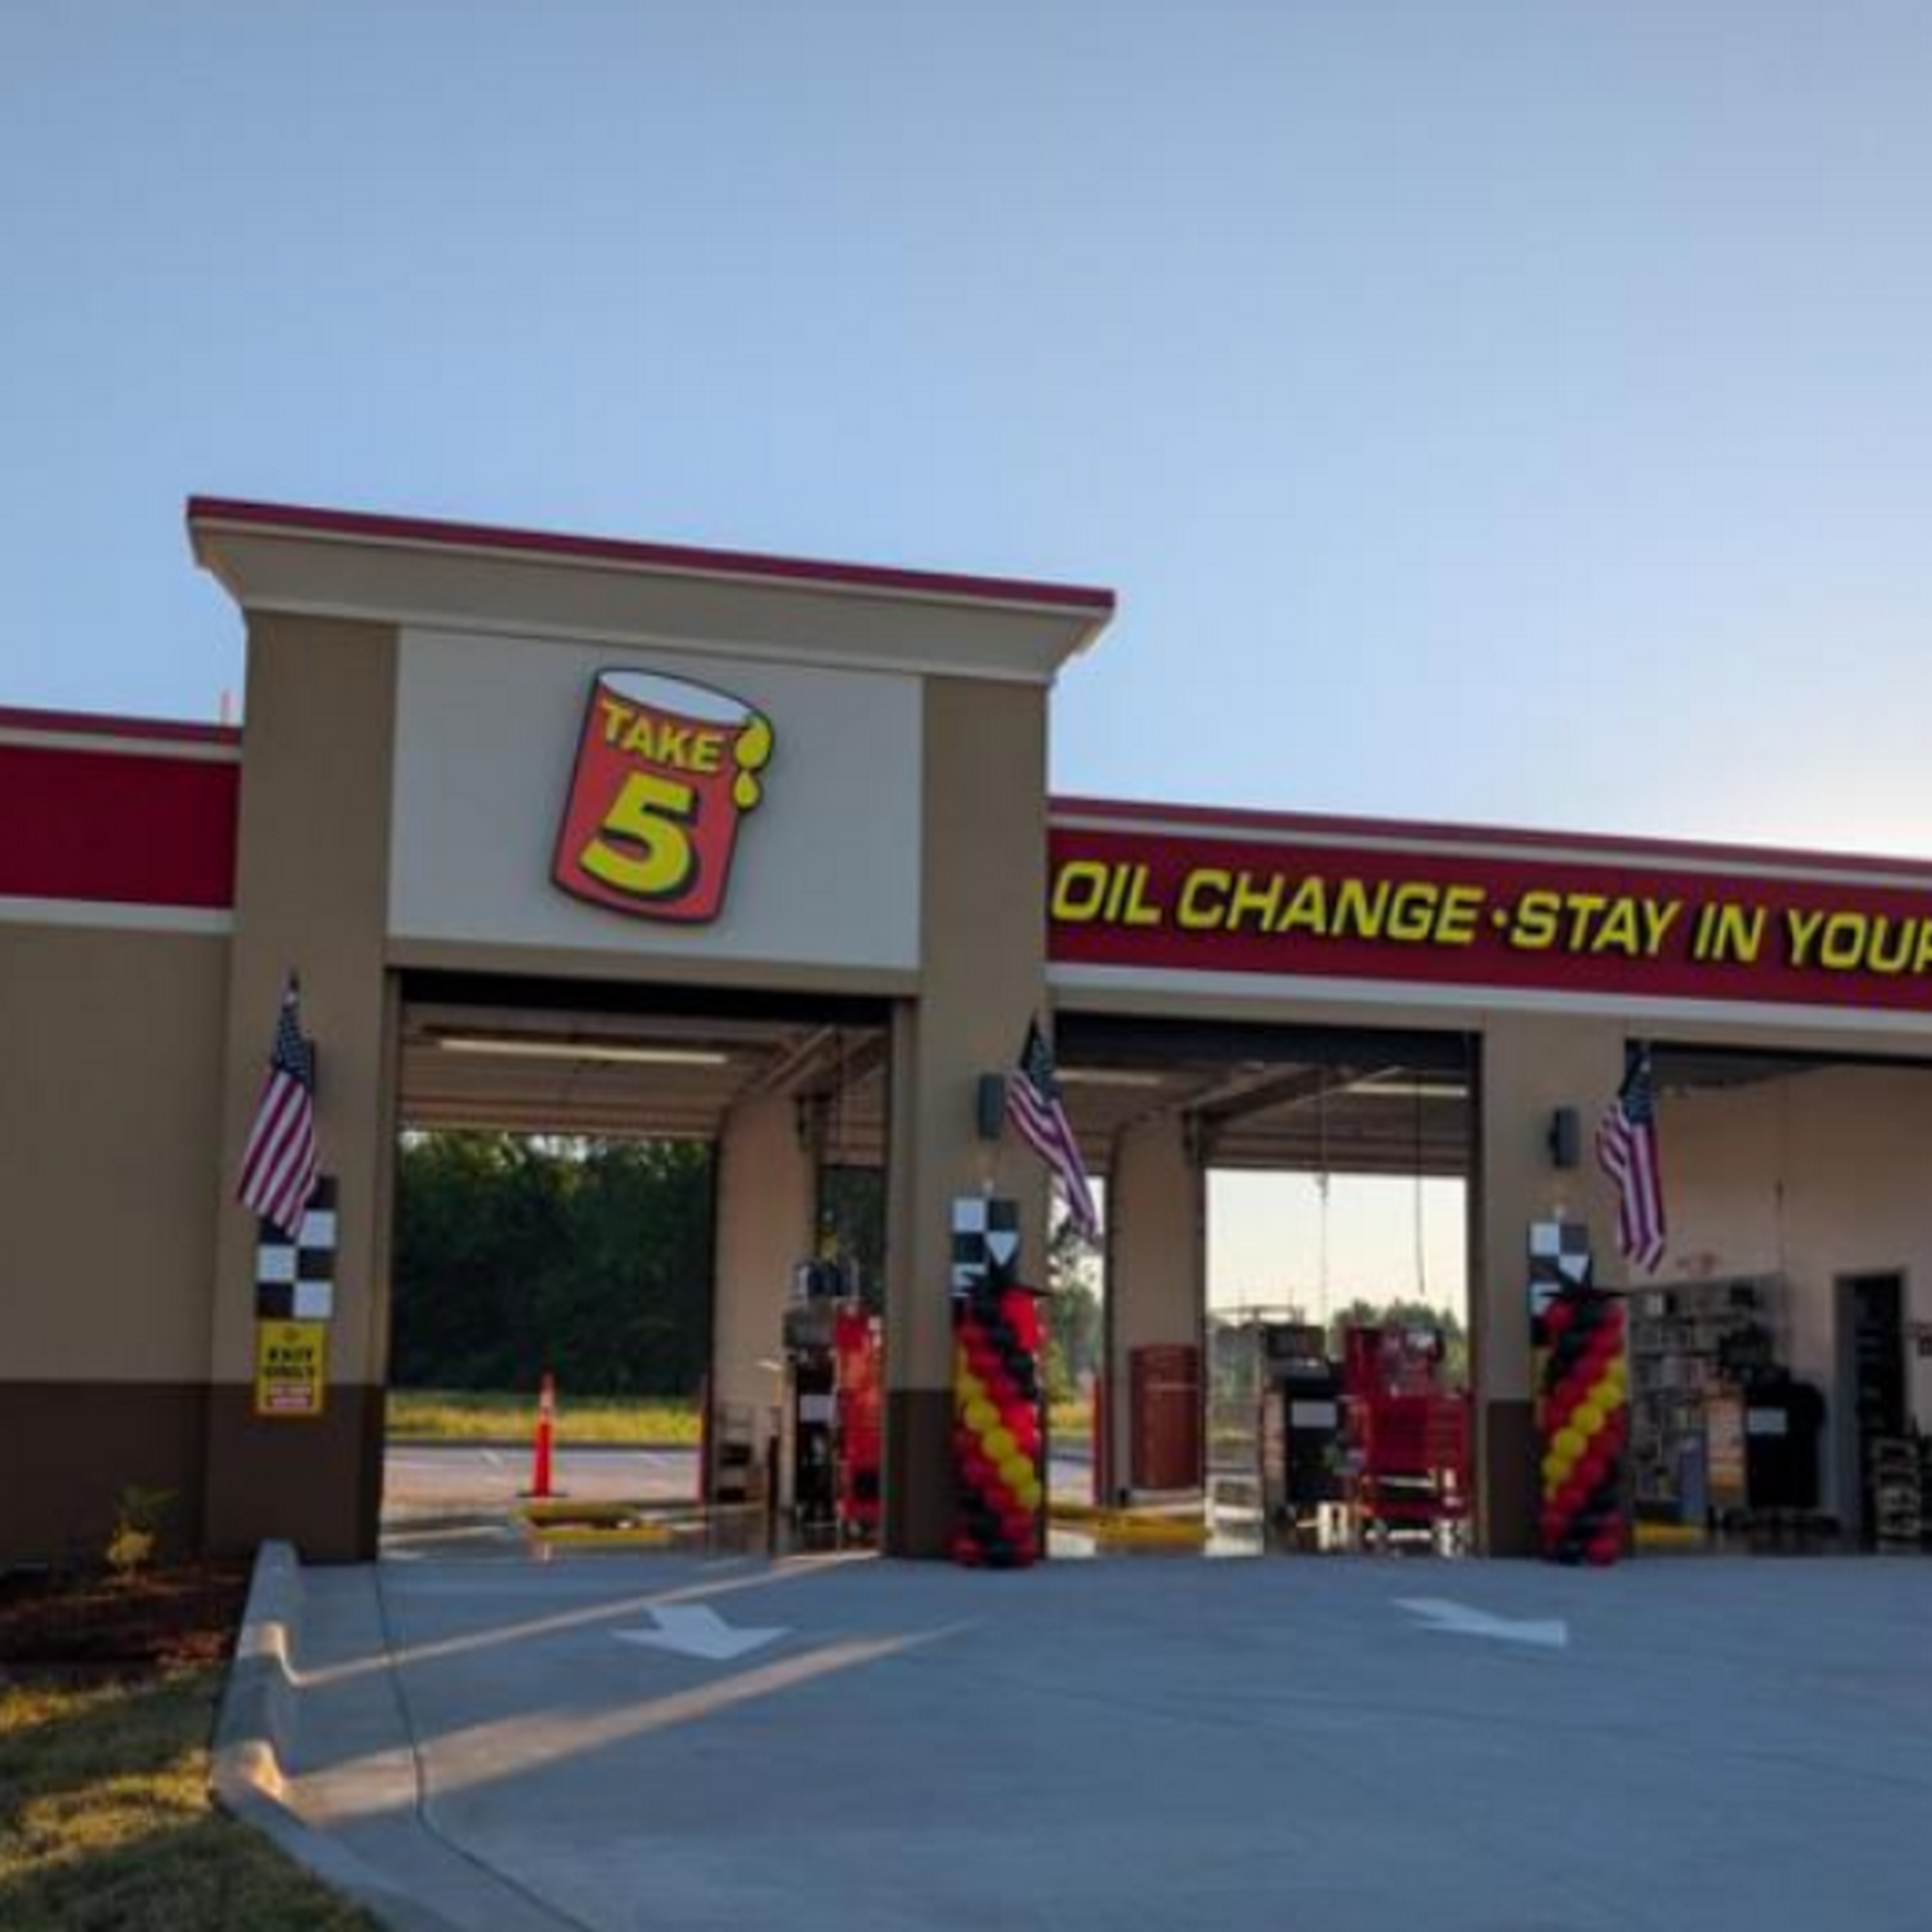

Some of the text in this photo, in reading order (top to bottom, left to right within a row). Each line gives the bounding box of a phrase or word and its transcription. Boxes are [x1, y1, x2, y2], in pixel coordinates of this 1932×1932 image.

[601, 698, 724, 773] TAKE
[581, 771, 694, 894] 5
[1051, 861, 1161, 924] OIL
[1177, 869, 1486, 943] CHANGE
[1511, 891, 1681, 956] STAY
[1692, 901, 1767, 962] IN
